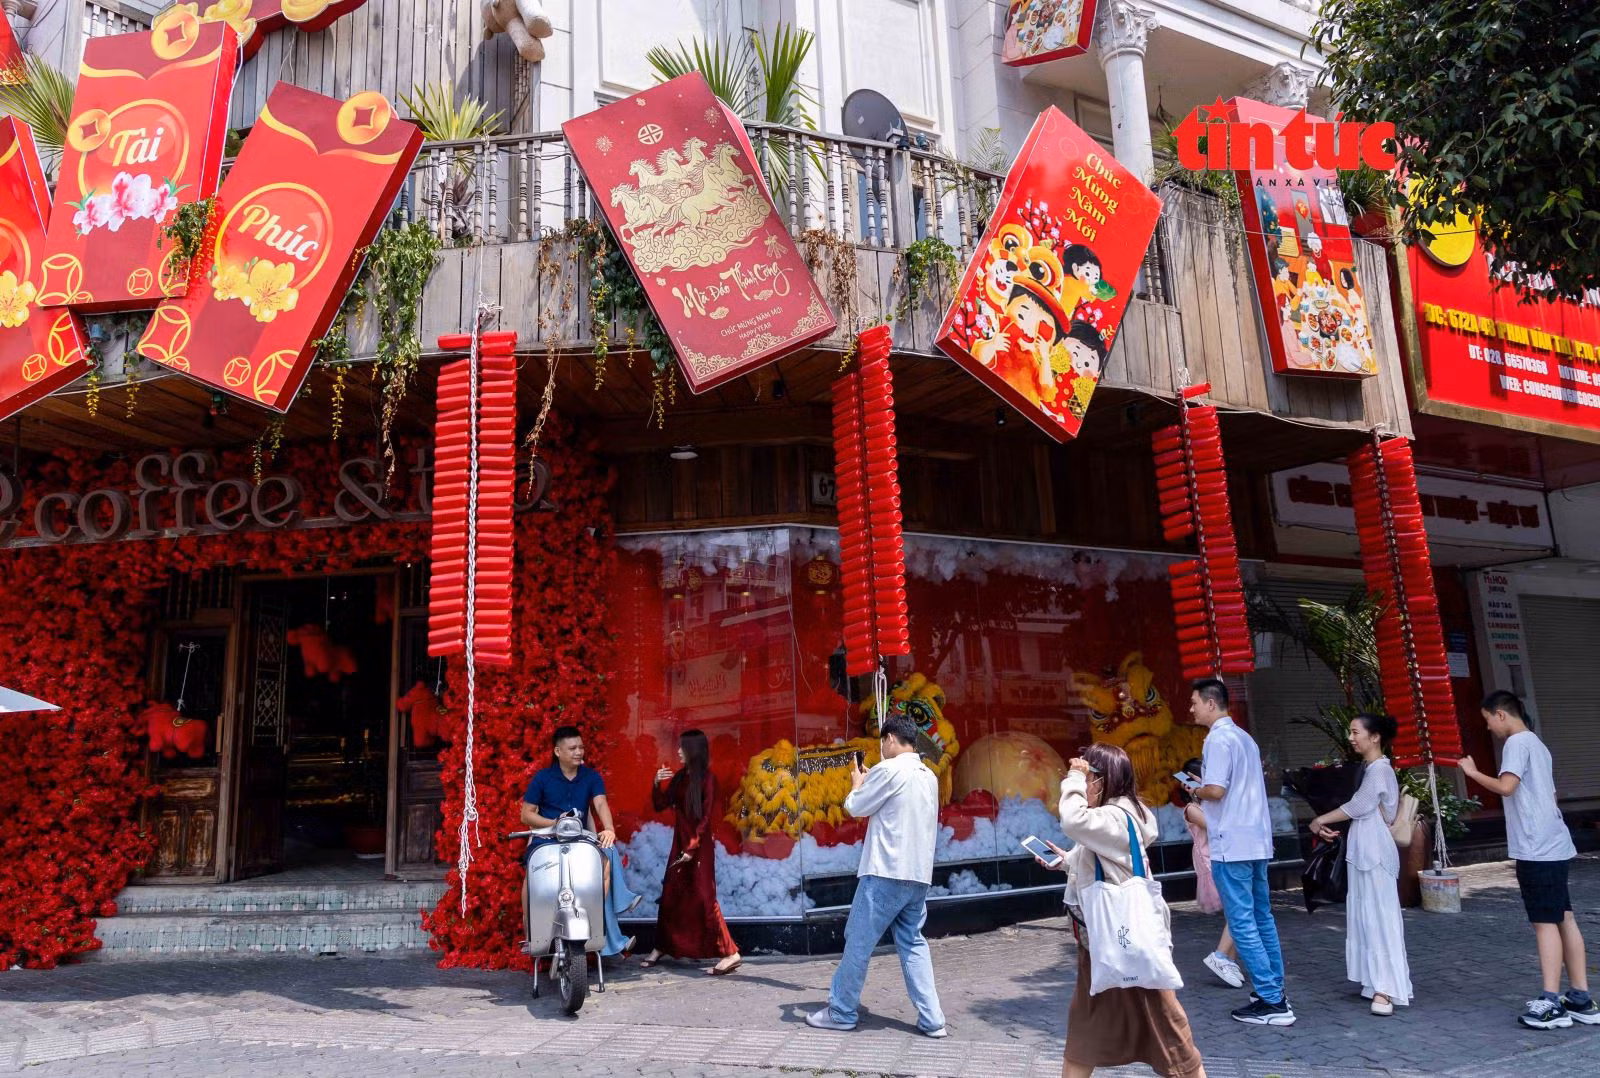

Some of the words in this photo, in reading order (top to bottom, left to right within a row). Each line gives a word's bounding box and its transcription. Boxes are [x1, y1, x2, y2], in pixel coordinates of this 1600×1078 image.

[109, 127, 165, 167] Tài
[1086, 153, 1121, 189] Chúc
[1068, 186, 1106, 226] Năm
[1072, 166, 1119, 215] Mừng
[238, 204, 319, 262] Phúc
[1063, 207, 1097, 243] Mới
[753, 261, 794, 297] Công
[738, 328, 757, 340] HAPPY
[756, 321, 772, 332] YEAR
[1499, 374, 1523, 392] WEB:
[1557, 364, 1593, 385] HOTLINE:
[34, 452, 301, 542] coffee
[334, 457, 394, 522] &
